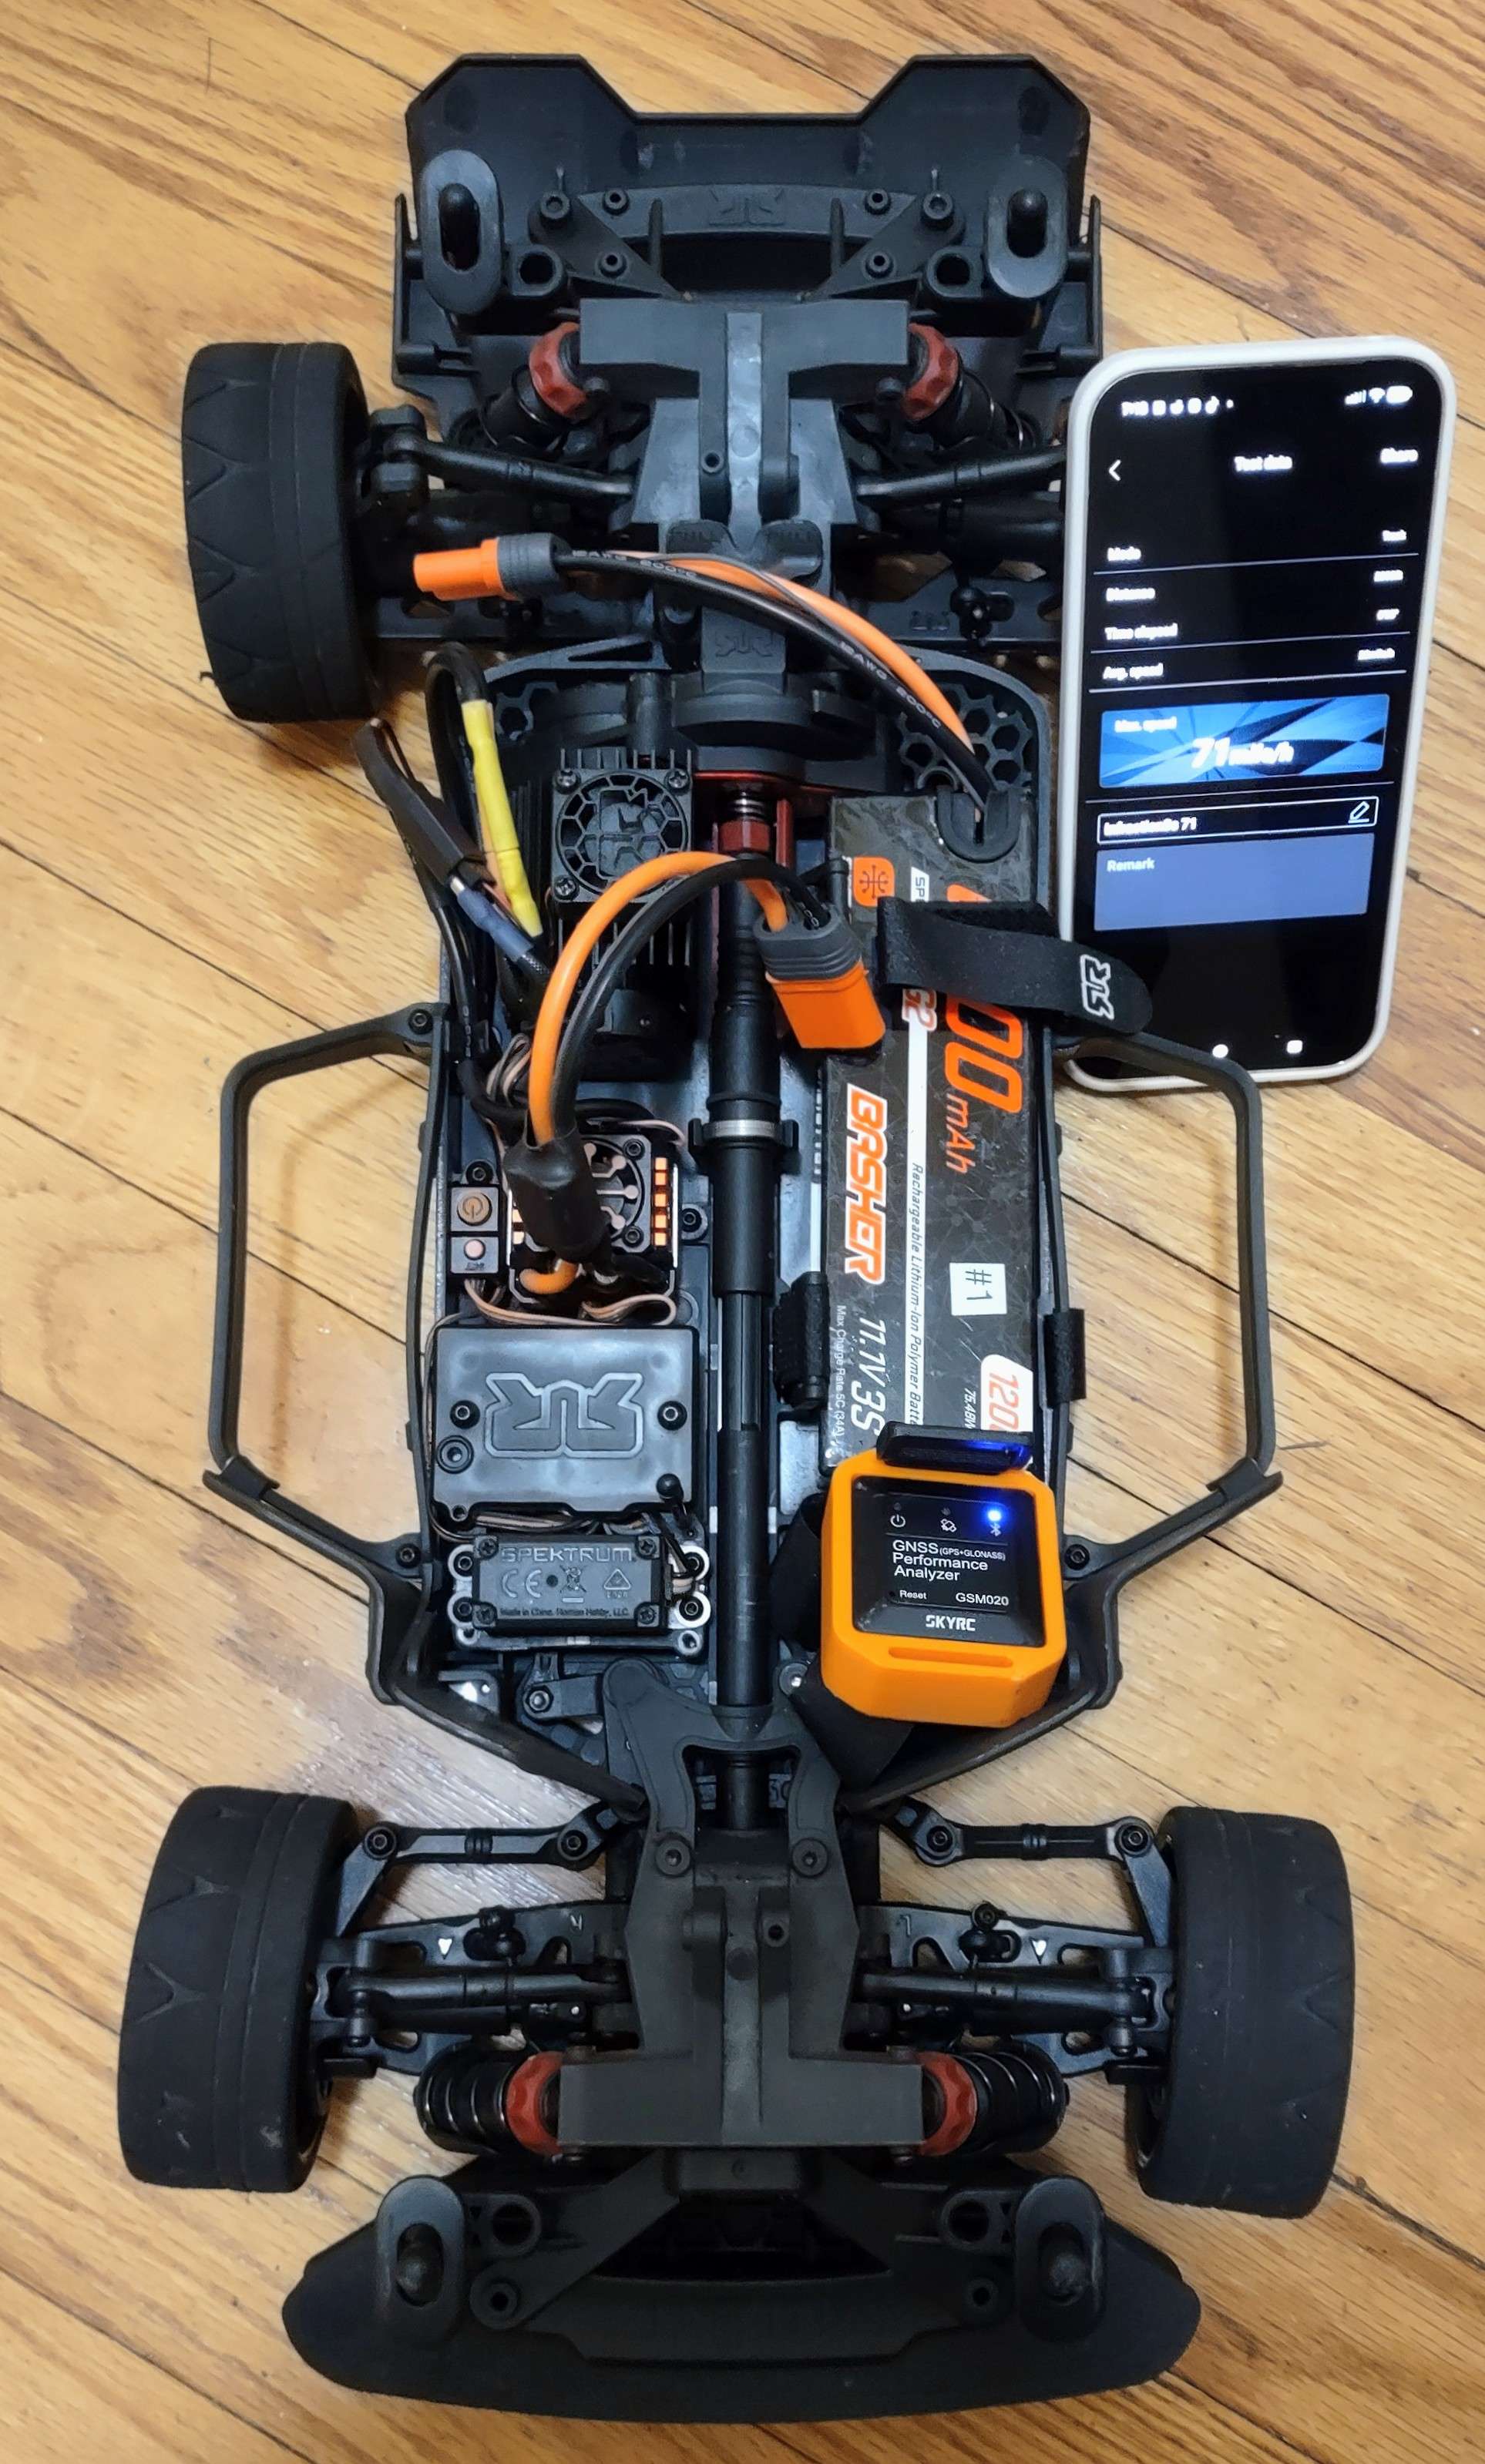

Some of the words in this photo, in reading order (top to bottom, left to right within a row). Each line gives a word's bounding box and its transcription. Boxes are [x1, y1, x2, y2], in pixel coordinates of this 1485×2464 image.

[1107, 858, 1155, 872] Remark
[946, 1093, 976, 1174] mAh
[845, 1083, 888, 1285] BASHER
[909, 1162, 924, 1252] Rechargeable
[909, 1255, 923, 1333] Lithium-Ion
[965, 1268, 993, 1301] #1
[836, 1304, 847, 1327] Max
[834, 1328, 847, 1366] Charge
[858, 1316, 887, 1388] 11.1V
[907, 1334, 923, 1390] Polymer
[835, 1366, 846, 1392] Rate
[835, 1393, 845, 1408] 5C
[850, 1379, 887, 1436] 3S
[834, 1408, 846, 1436] (34A)
[501, 1546, 633, 1563] SPEKTRUM
[892, 1539, 939, 1554] GNSS
[939, 1547, 1006, 1561] (GPS+GLONASS)
[892, 1552, 988, 1571] Performance
[894, 1565, 961, 1582] Analyzer
[899, 1590, 927, 1600] Reset
[956, 1592, 1010, 1606] GSM020
[925, 1614, 976, 1632] SKYRC
